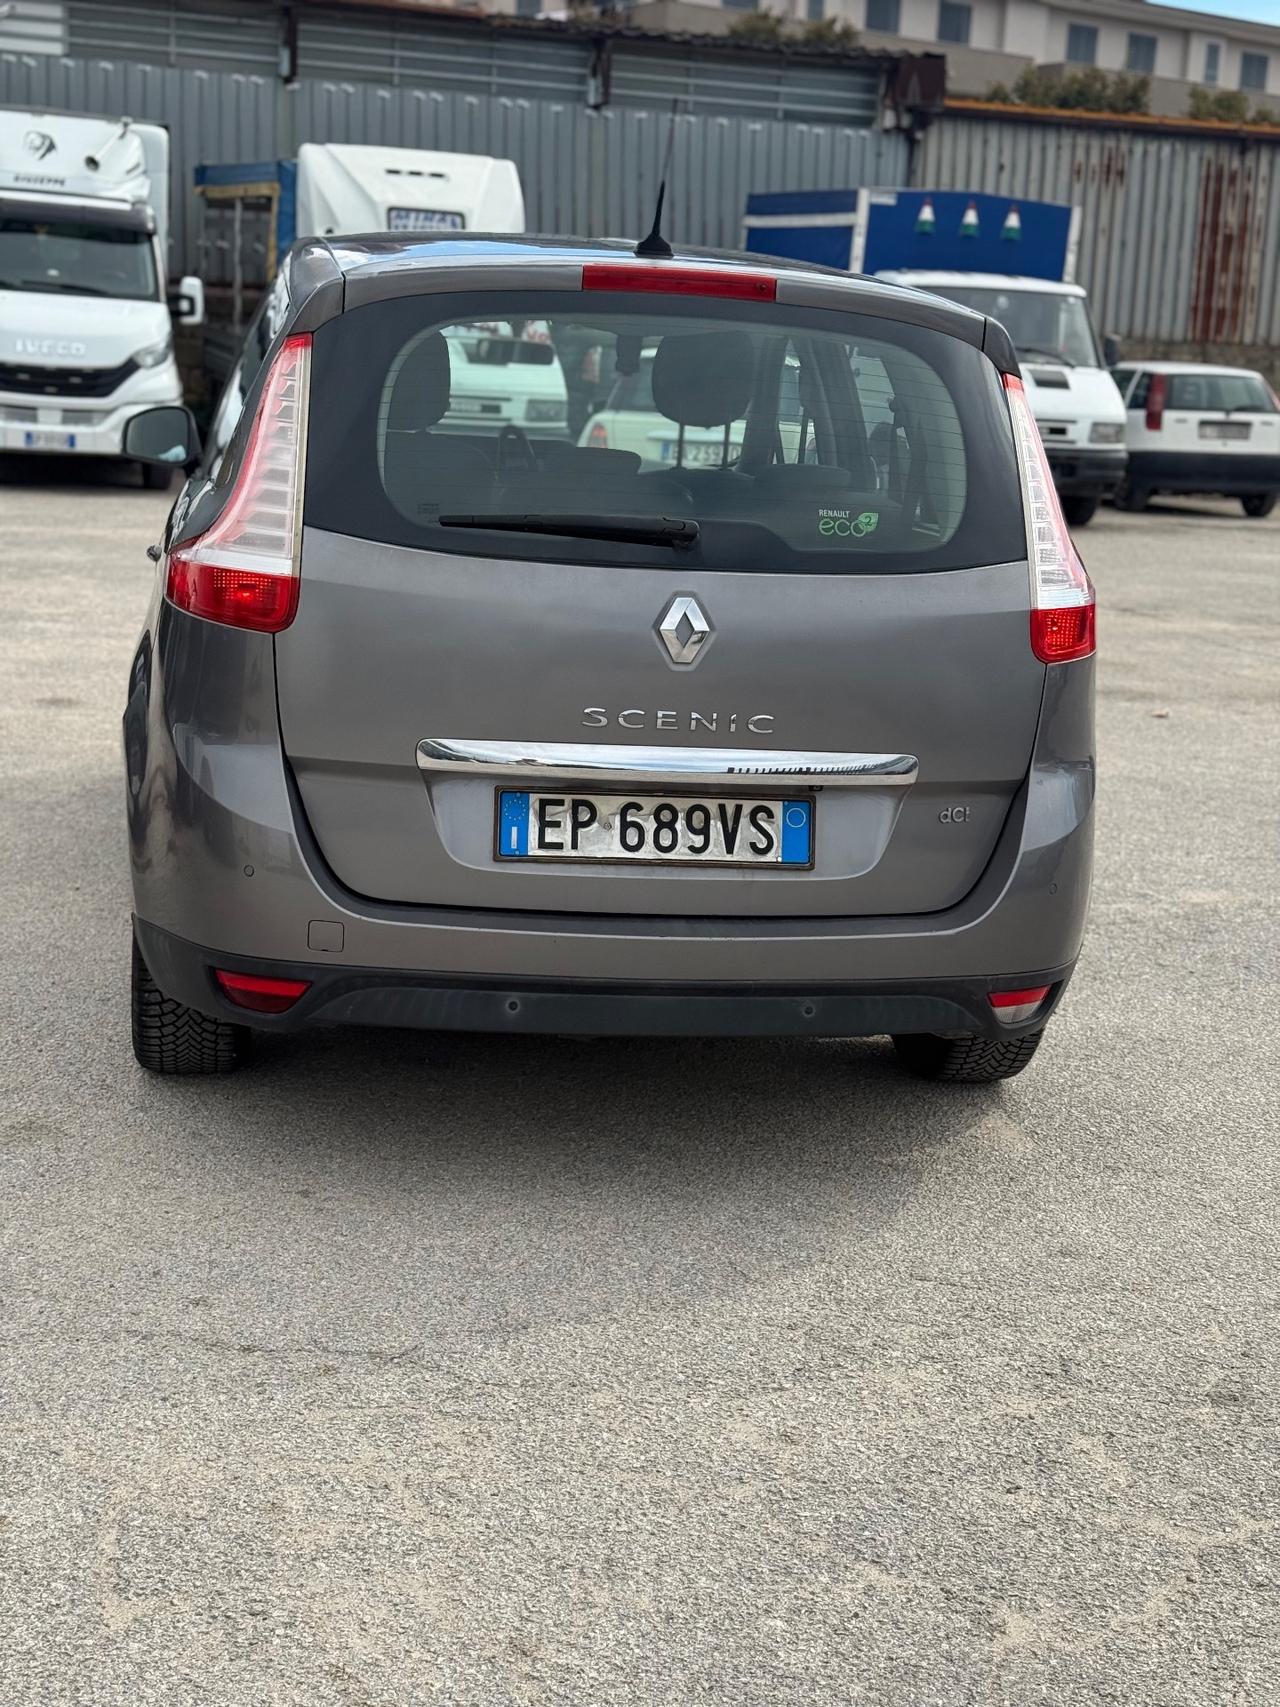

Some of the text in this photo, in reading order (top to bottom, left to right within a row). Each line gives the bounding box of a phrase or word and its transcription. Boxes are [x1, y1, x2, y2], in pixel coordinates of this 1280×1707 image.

[15, 338, 87, 356] IVECO
[818, 509, 850, 518] RENAULT
[582, 707, 775, 734] SCENIC
[536, 798, 598, 850] EP
[619, 801, 775, 855] 689VS
